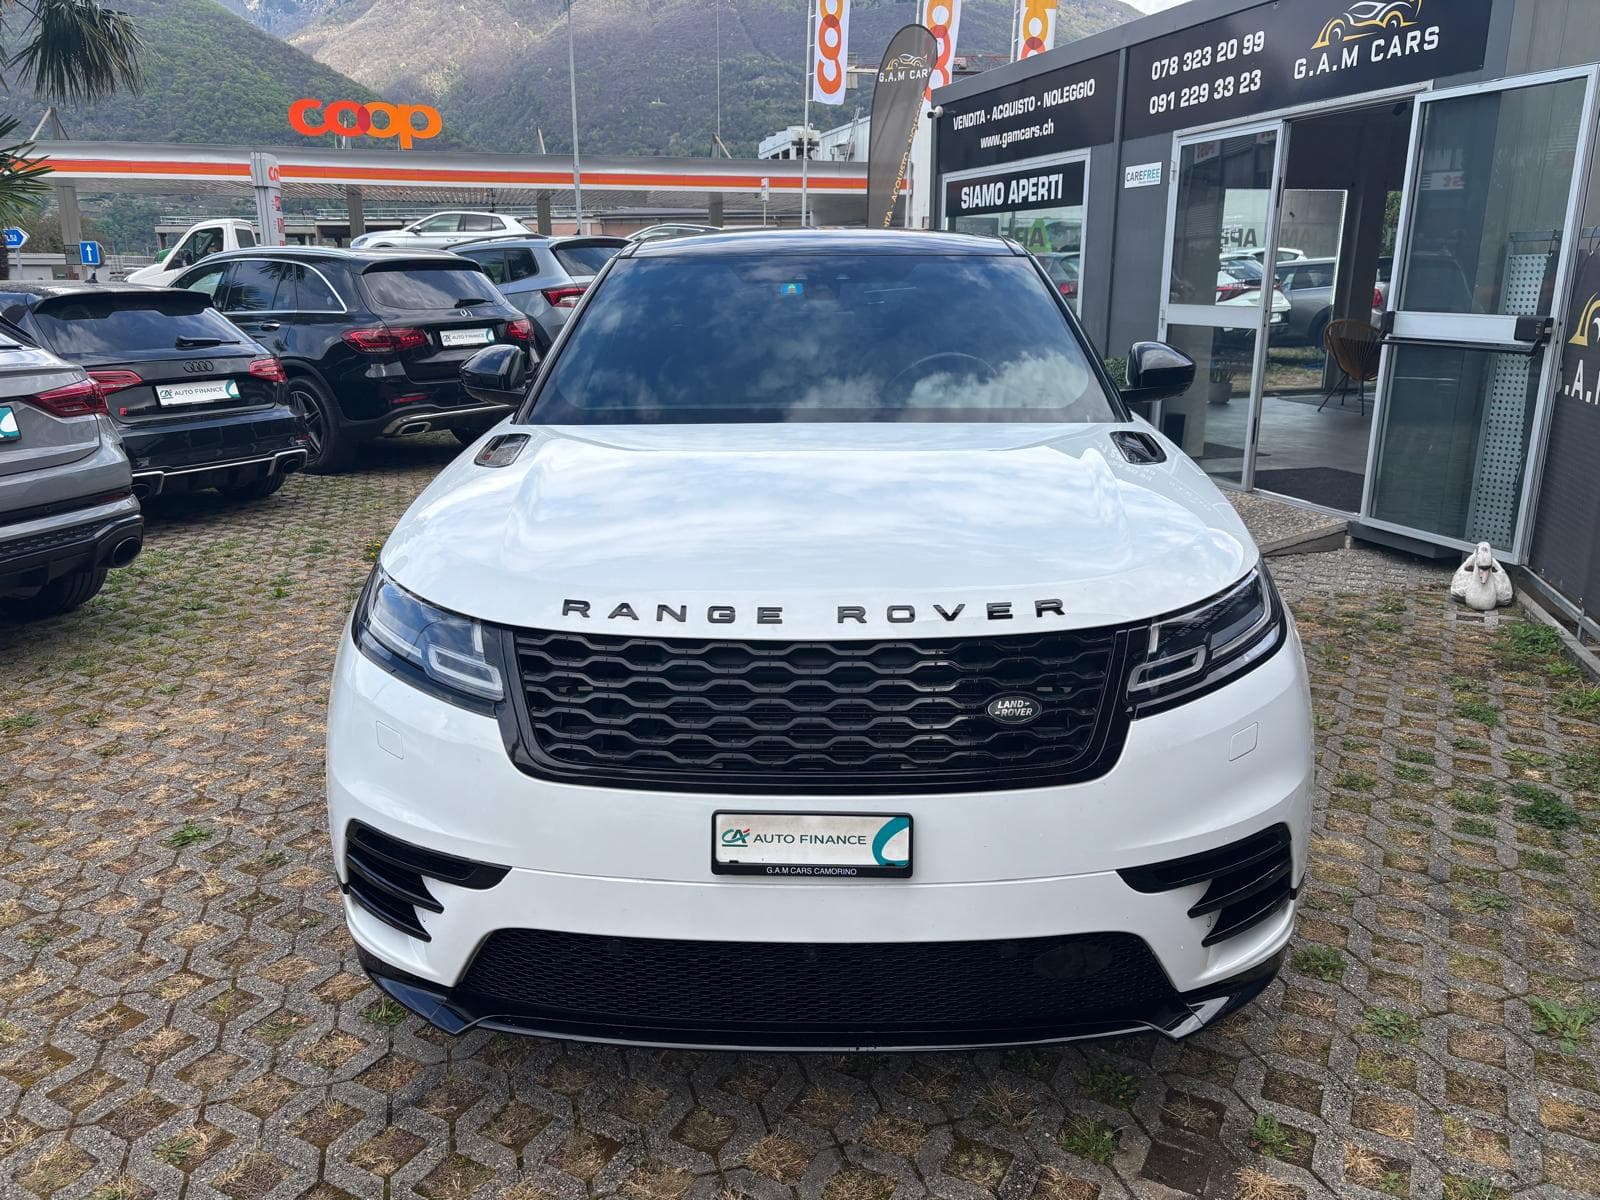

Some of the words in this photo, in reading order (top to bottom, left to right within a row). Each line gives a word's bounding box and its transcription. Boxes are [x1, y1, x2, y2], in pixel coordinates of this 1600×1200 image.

[1151, 55, 1179, 81] 078
[1182, 45, 1212, 72] 323
[1216, 38, 1238, 63] 20
[1242, 30, 1265, 56] 99
[1293, 44, 1359, 80] G.A.M
[1370, 25, 1440, 63] CARS
[879, 70, 905, 83] G.A.M
[1149, 91, 1176, 115] 091
[1179, 82, 1209, 108] 229
[1213, 75, 1235, 100] 33
[1239, 69, 1262, 95] 23
[953, 109, 986, 131] VENDITA
[991, 95, 1036, 121] ACQUISTO
[1043, 78, 1096, 108] NOLEGGIO
[288, 98, 442, 150] coop
[980, 118, 1054, 149] www.gamcars.ch
[1126, 168, 1161, 182] CAREFREE
[961, 181, 1005, 209] SIAMO
[1007, 173, 1064, 204] APERTI
[195, 386, 225, 394] FINANCE
[562, 598, 783, 625] RANGE
[837, 598, 1066, 624] ROVER
[753, 834, 795, 844] AUTO
[799, 834, 867, 845] FINANCE
[766, 866, 789, 875] G.A.M
[790, 867, 813, 876] CARS
[813, 867, 857, 876] CAMORINO
